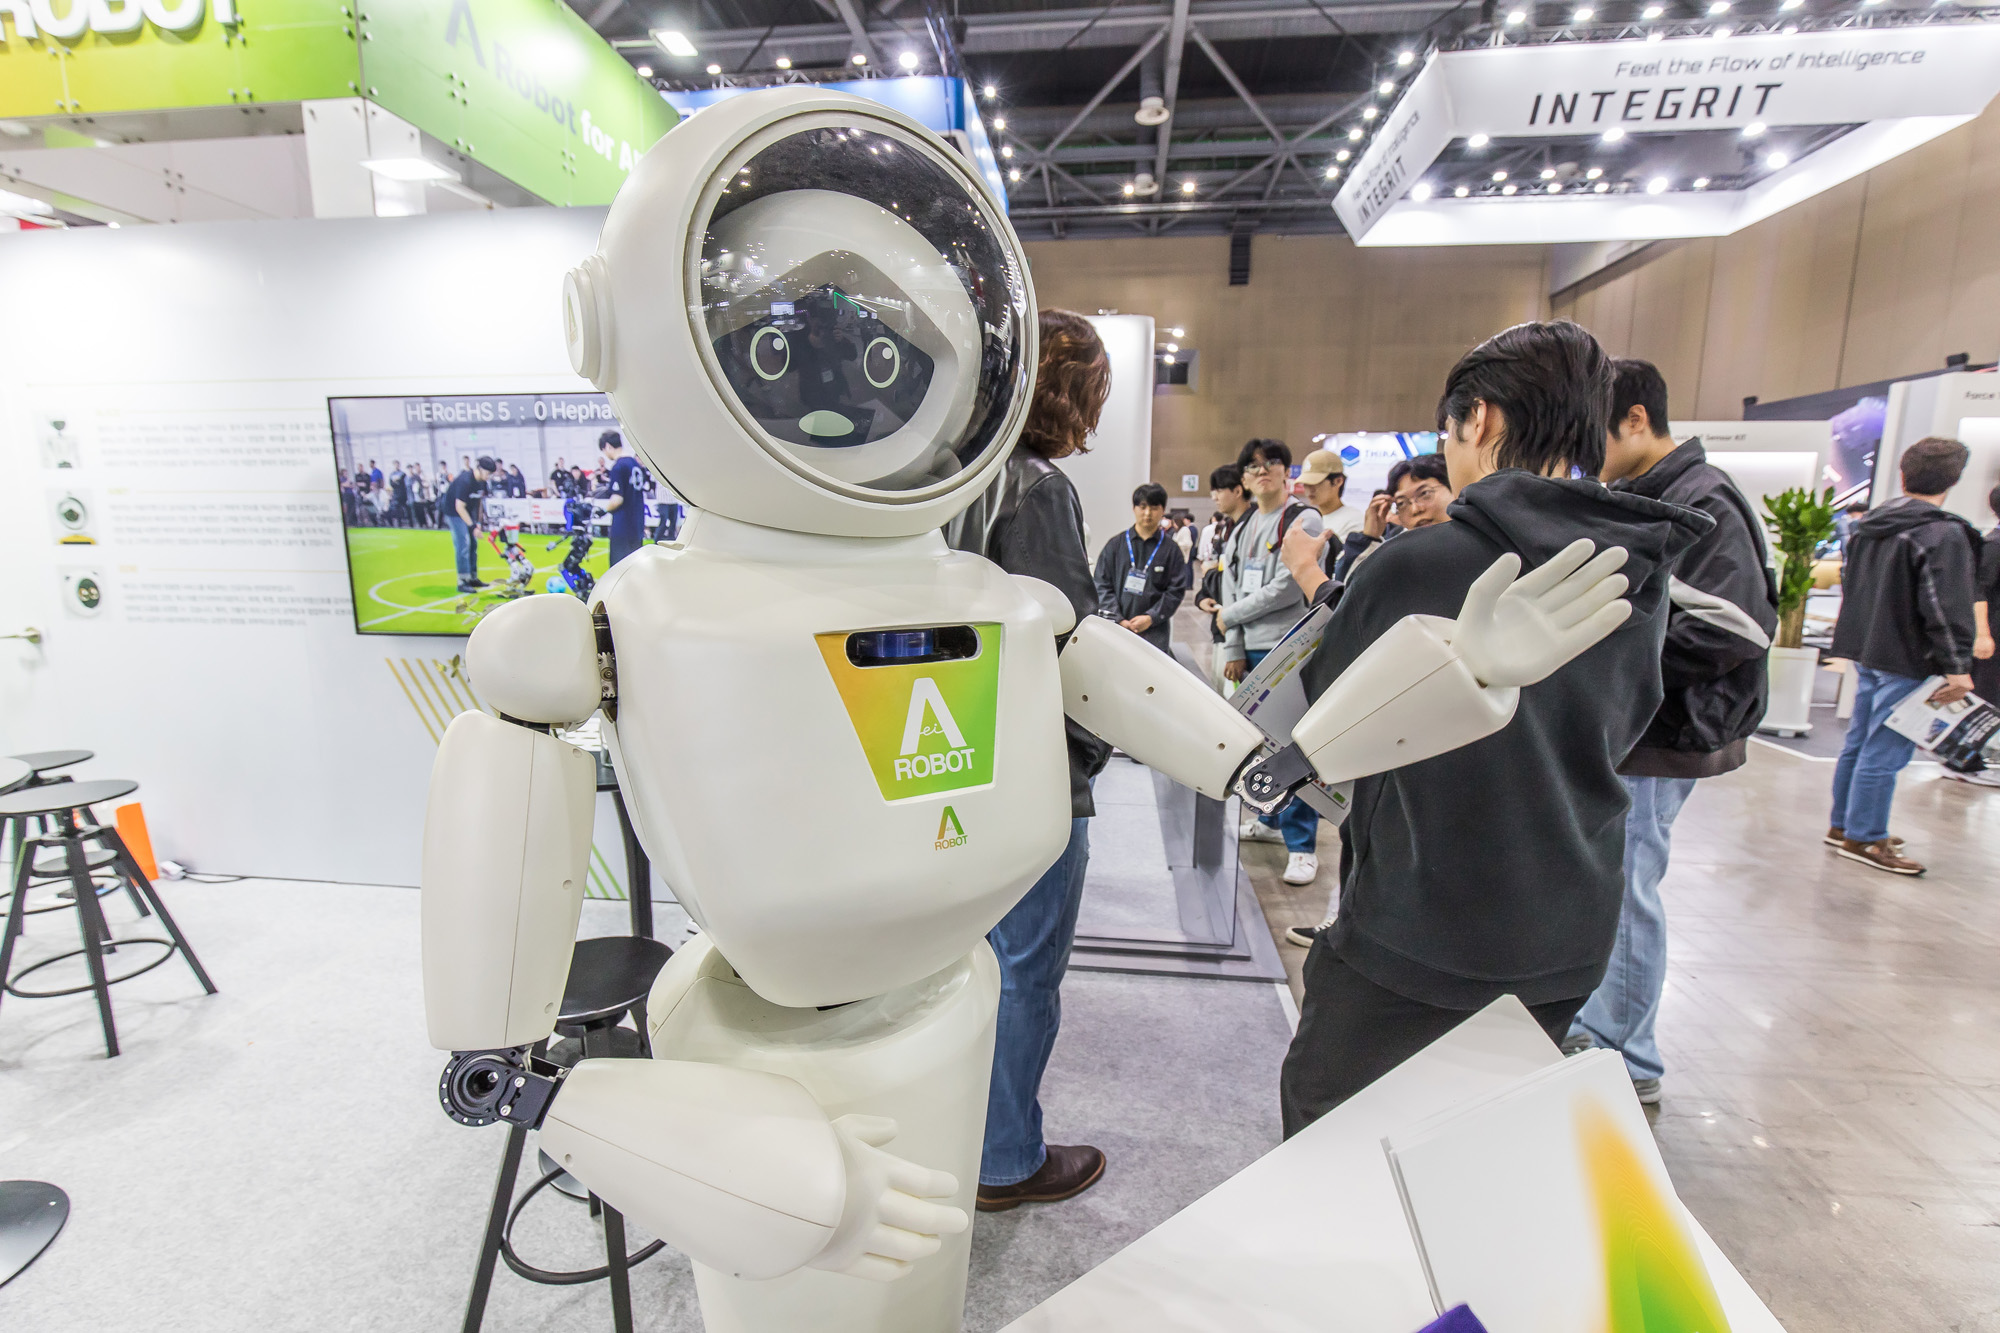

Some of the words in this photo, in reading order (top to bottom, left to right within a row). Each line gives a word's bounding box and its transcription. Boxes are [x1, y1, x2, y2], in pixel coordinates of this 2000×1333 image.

[1615, 61, 1661, 78] Feel
[1667, 58, 1702, 76] the
[1708, 54, 1763, 73] Flow
[1768, 52, 1794, 71] of
[1796, 49, 1926, 72] Intelligence
[493, 40, 578, 136] Robot
[581, 109, 615, 162] for
[1528, 82, 1783, 126] INTEGRIT
[1357, 155, 1407, 224] INTEGRIT
[406, 402, 494, 423] HERoEHS
[498, 401, 511, 421] 5
[534, 401, 548, 421] 0
[552, 400, 616, 424] Hepha
[1287, 632, 1308, 648] HALL
[1239, 681, 1256, 699] HALL
[894, 748, 976, 781] ROBOT
[934, 834, 969, 852] ROBOT
